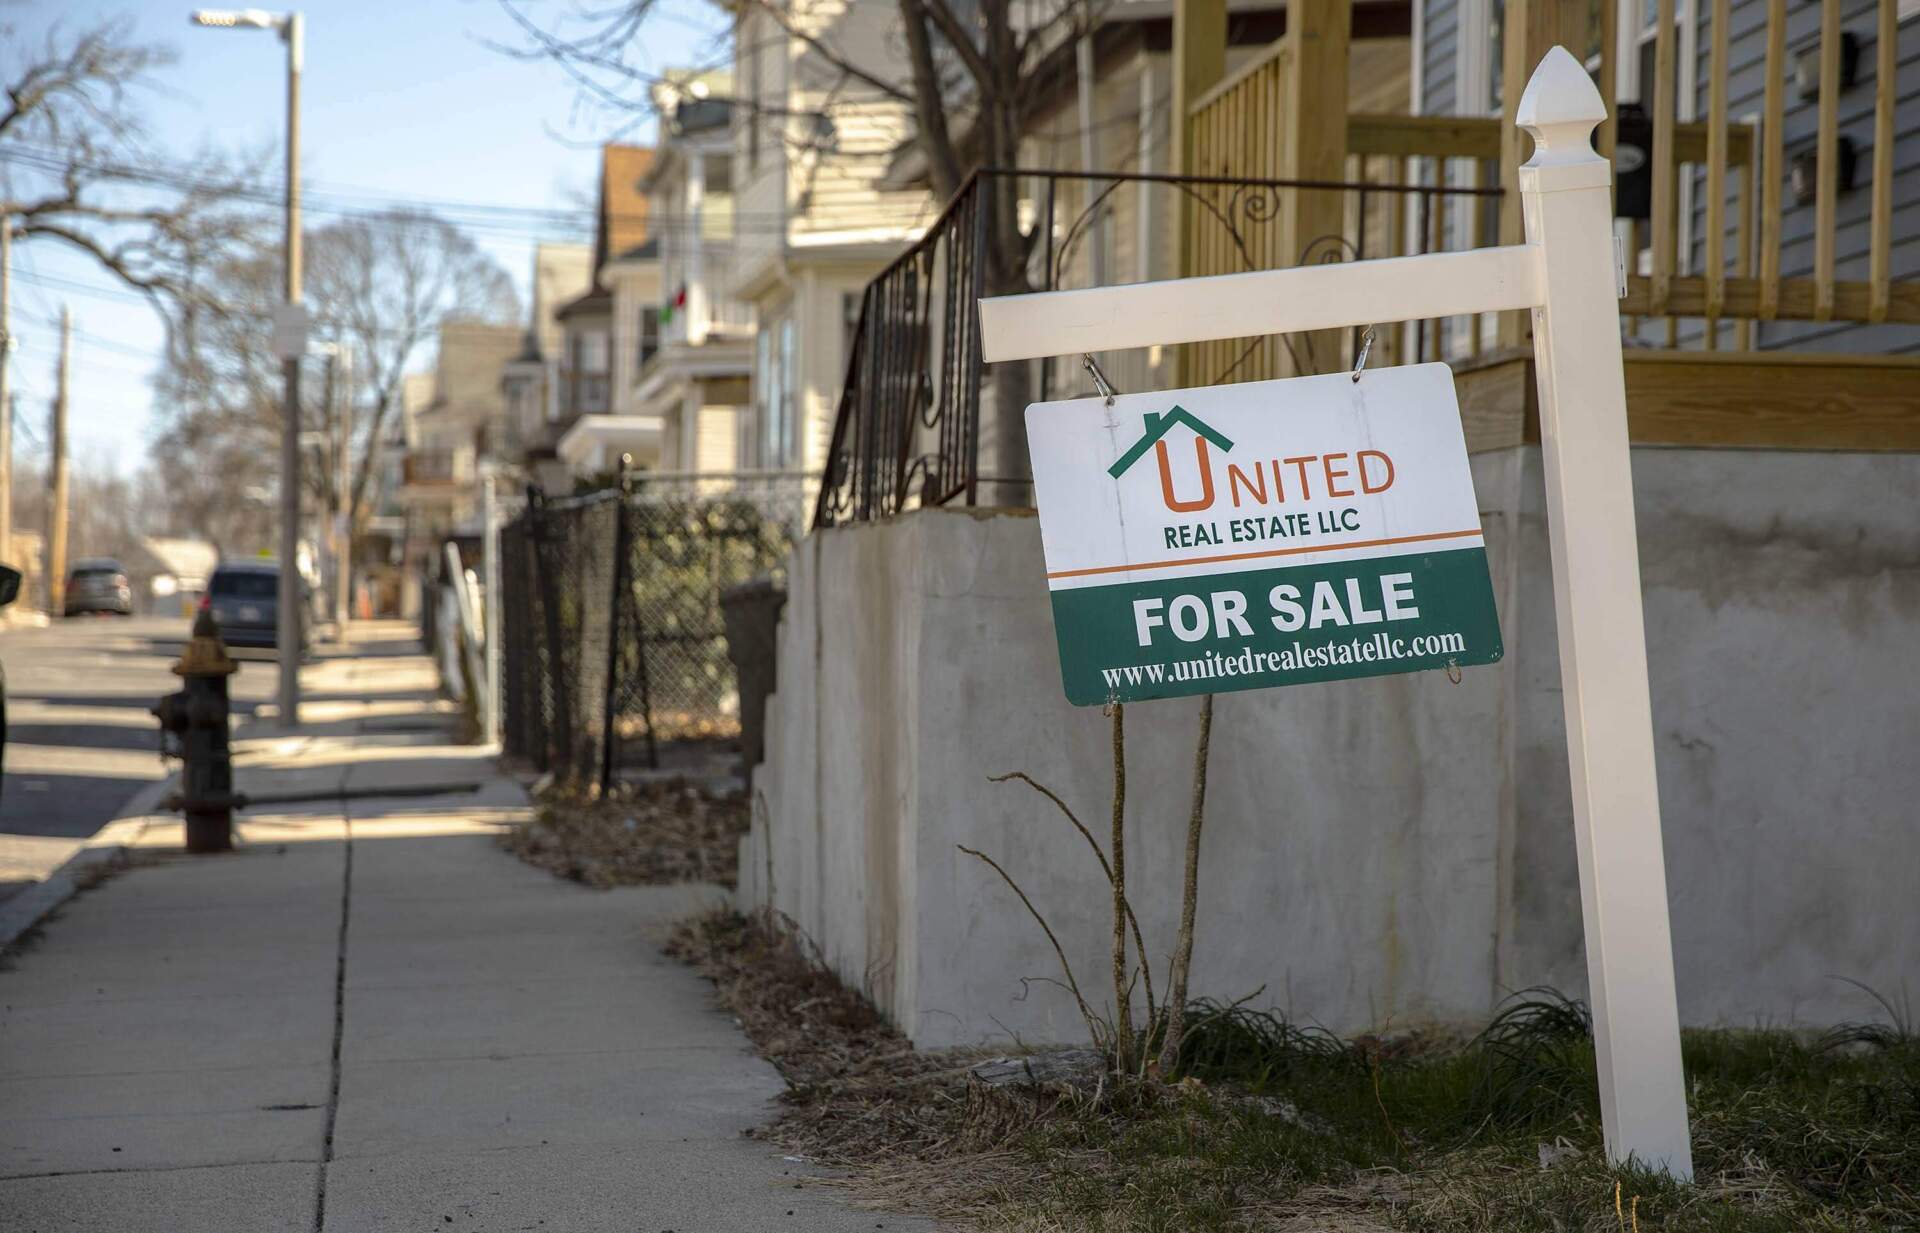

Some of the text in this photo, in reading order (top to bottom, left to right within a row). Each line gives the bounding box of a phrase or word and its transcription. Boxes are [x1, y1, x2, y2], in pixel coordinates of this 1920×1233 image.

[1155, 435, 1395, 513] UNITED
[1163, 508, 1361, 549] REAL ESTATE LLC
[1132, 572, 1420, 647] FOR SALE
[1101, 632, 1466, 689] www.unitedrealestatellc.com
